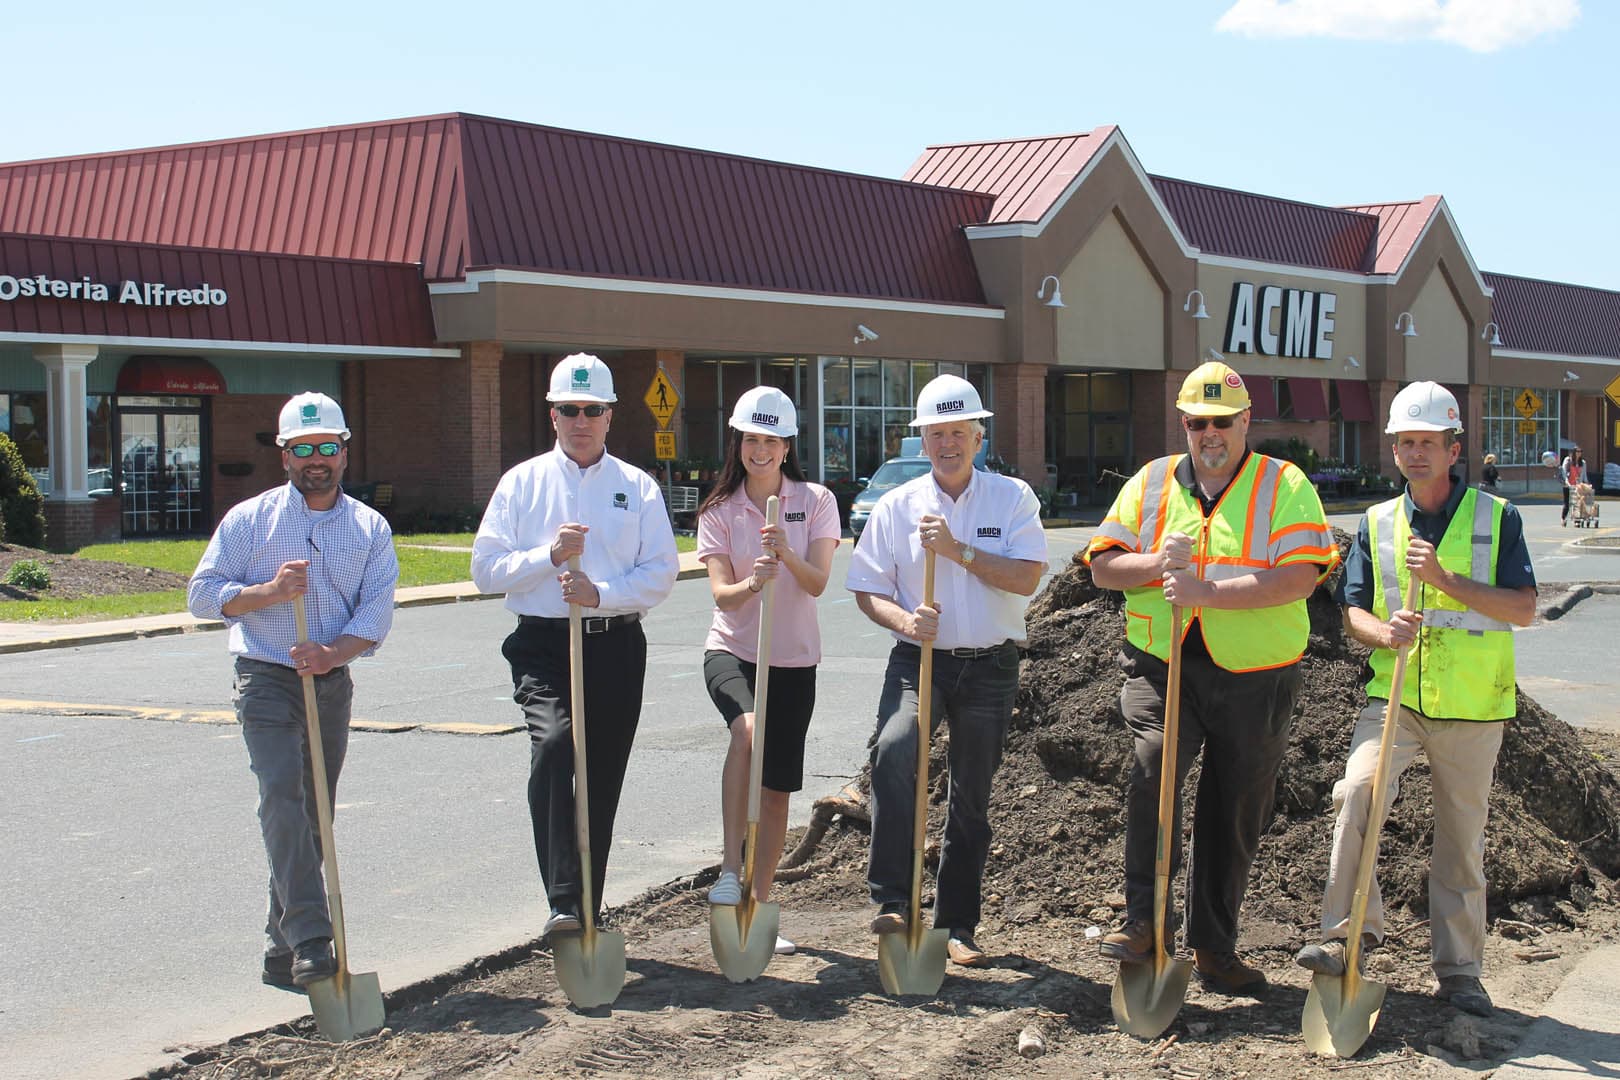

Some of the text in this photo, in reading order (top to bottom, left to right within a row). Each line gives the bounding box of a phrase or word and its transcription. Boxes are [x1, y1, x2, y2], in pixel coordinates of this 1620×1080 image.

[0, 274, 228, 306] Osteria Alfredo
[1223, 281, 1337, 360] ACME
[936, 399, 965, 412] RAUCH
[751, 412, 779, 425] RAUCH
[977, 527, 1001, 536] RAUCH
